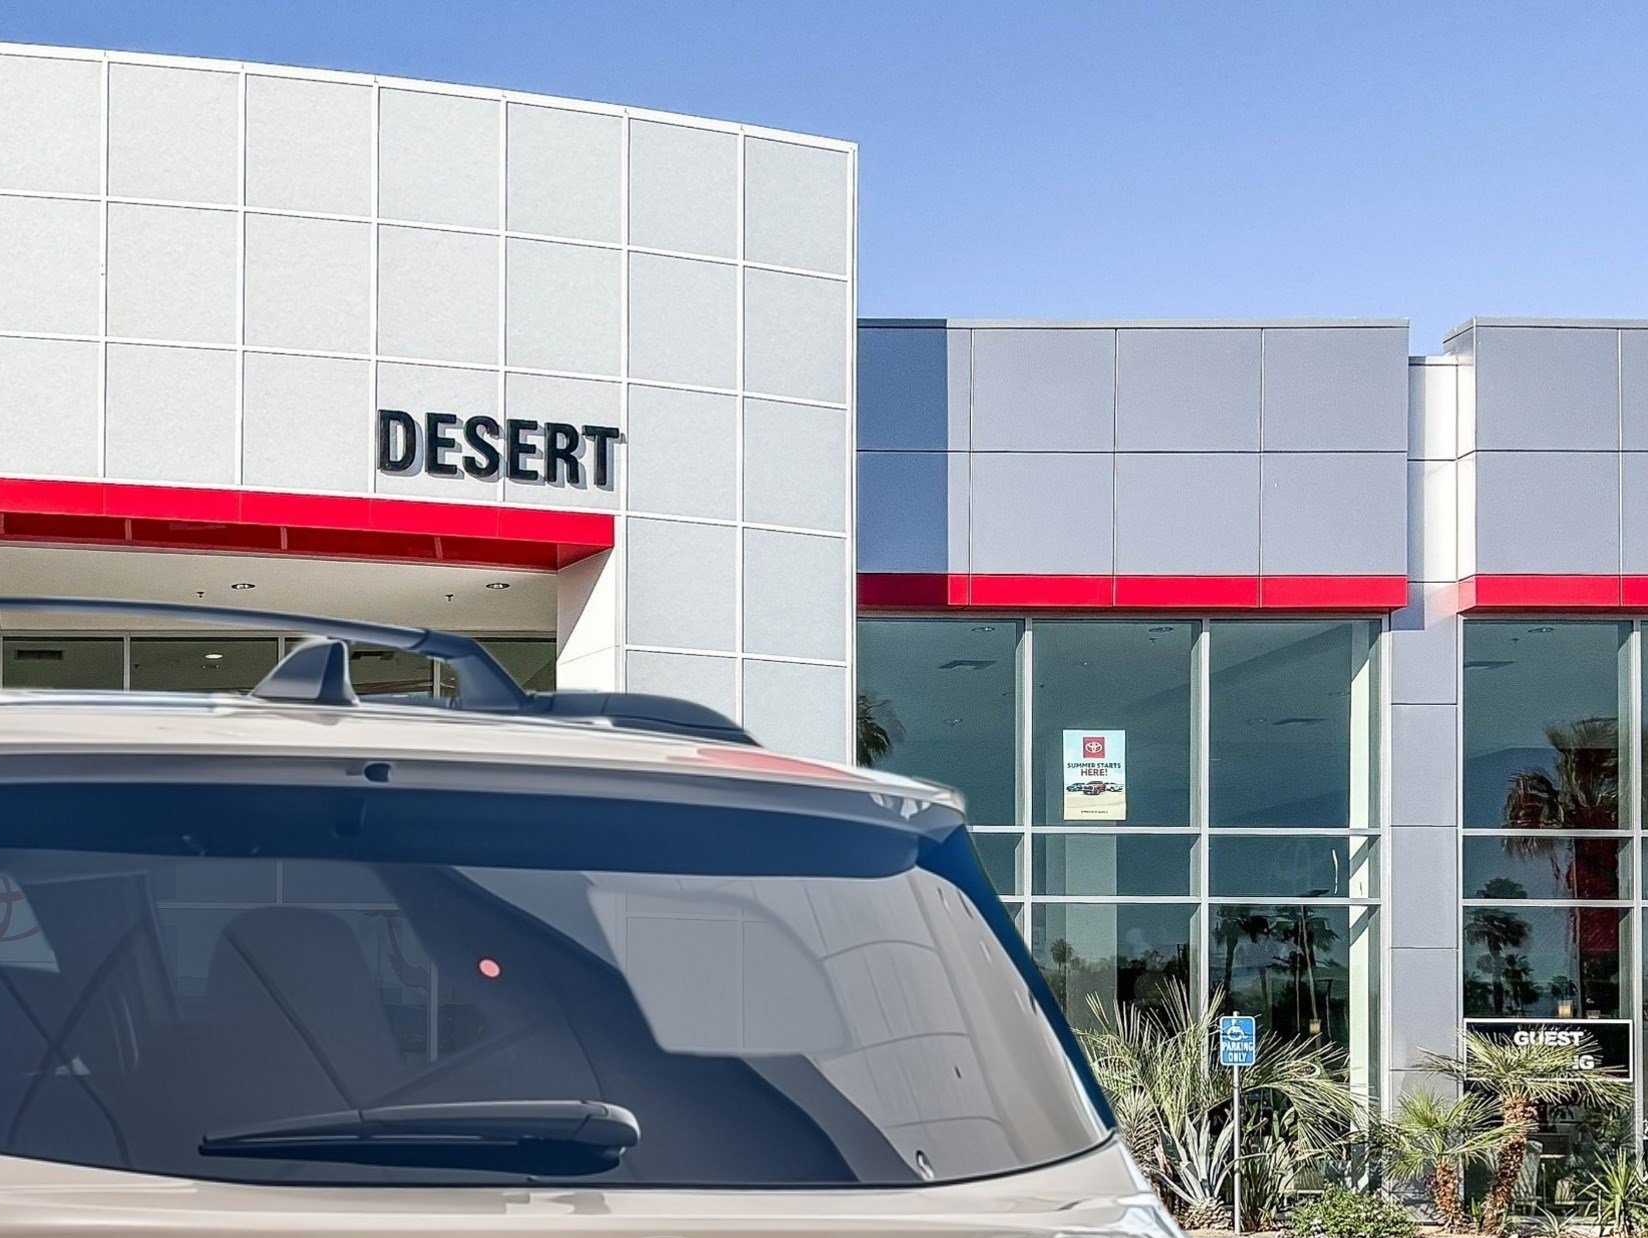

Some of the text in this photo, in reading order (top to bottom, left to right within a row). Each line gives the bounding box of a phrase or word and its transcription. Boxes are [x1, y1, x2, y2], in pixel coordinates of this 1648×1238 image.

[377, 409, 620, 487] DESERT
[1080, 768, 1108, 777] HERE!
[1513, 1031, 1584, 1047] GUEST
[1222, 1041, 1254, 1051] PARKING
[1228, 1051, 1247, 1062] ONLY
